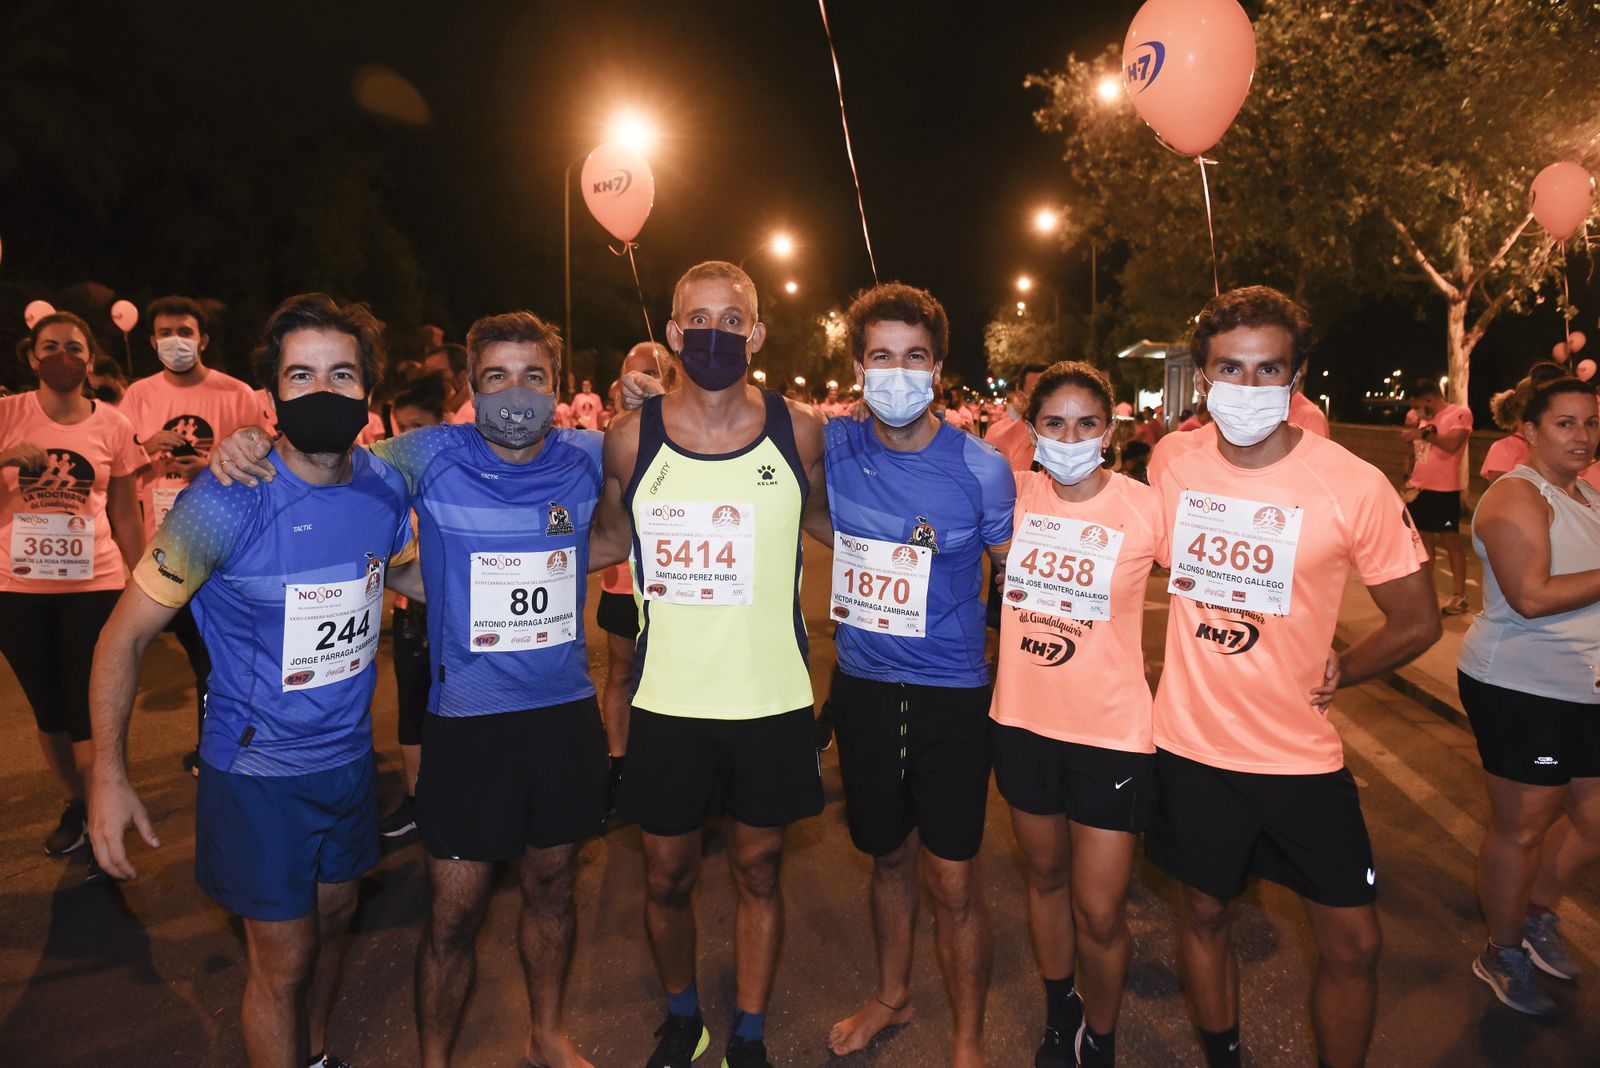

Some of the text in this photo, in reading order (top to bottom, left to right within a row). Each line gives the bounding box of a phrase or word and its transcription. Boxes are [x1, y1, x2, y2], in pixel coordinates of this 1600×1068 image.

[650, 461, 671, 495] GRAVITY
[292, 524, 313, 533] TACTIC
[24, 537, 83, 556] 3630
[656, 539, 736, 569] 5414
[1187, 533, 1274, 574] 4369
[655, 570, 687, 580] SANTIAGO
[715, 573, 737, 581] RUBIO
[1020, 548, 1095, 587] 4358
[1178, 562, 1284, 590] ALONSO MONTERO GALLEGO
[844, 568, 910, 605] 1870
[1043, 583, 1074, 595] MONTERO
[1075, 590, 1108, 601] GALLEGO
[510, 586, 549, 615] 80
[883, 605, 920, 617] ZAMBRANA
[315, 609, 370, 651] 244
[473, 612, 574, 629] ANTONIO PÁRRAGA ZAMBRANA
[1030, 612, 1083, 637] Guadalquivir
[290, 653, 319, 666] JORGE
[320, 647, 353, 662] PÁRRAGA
